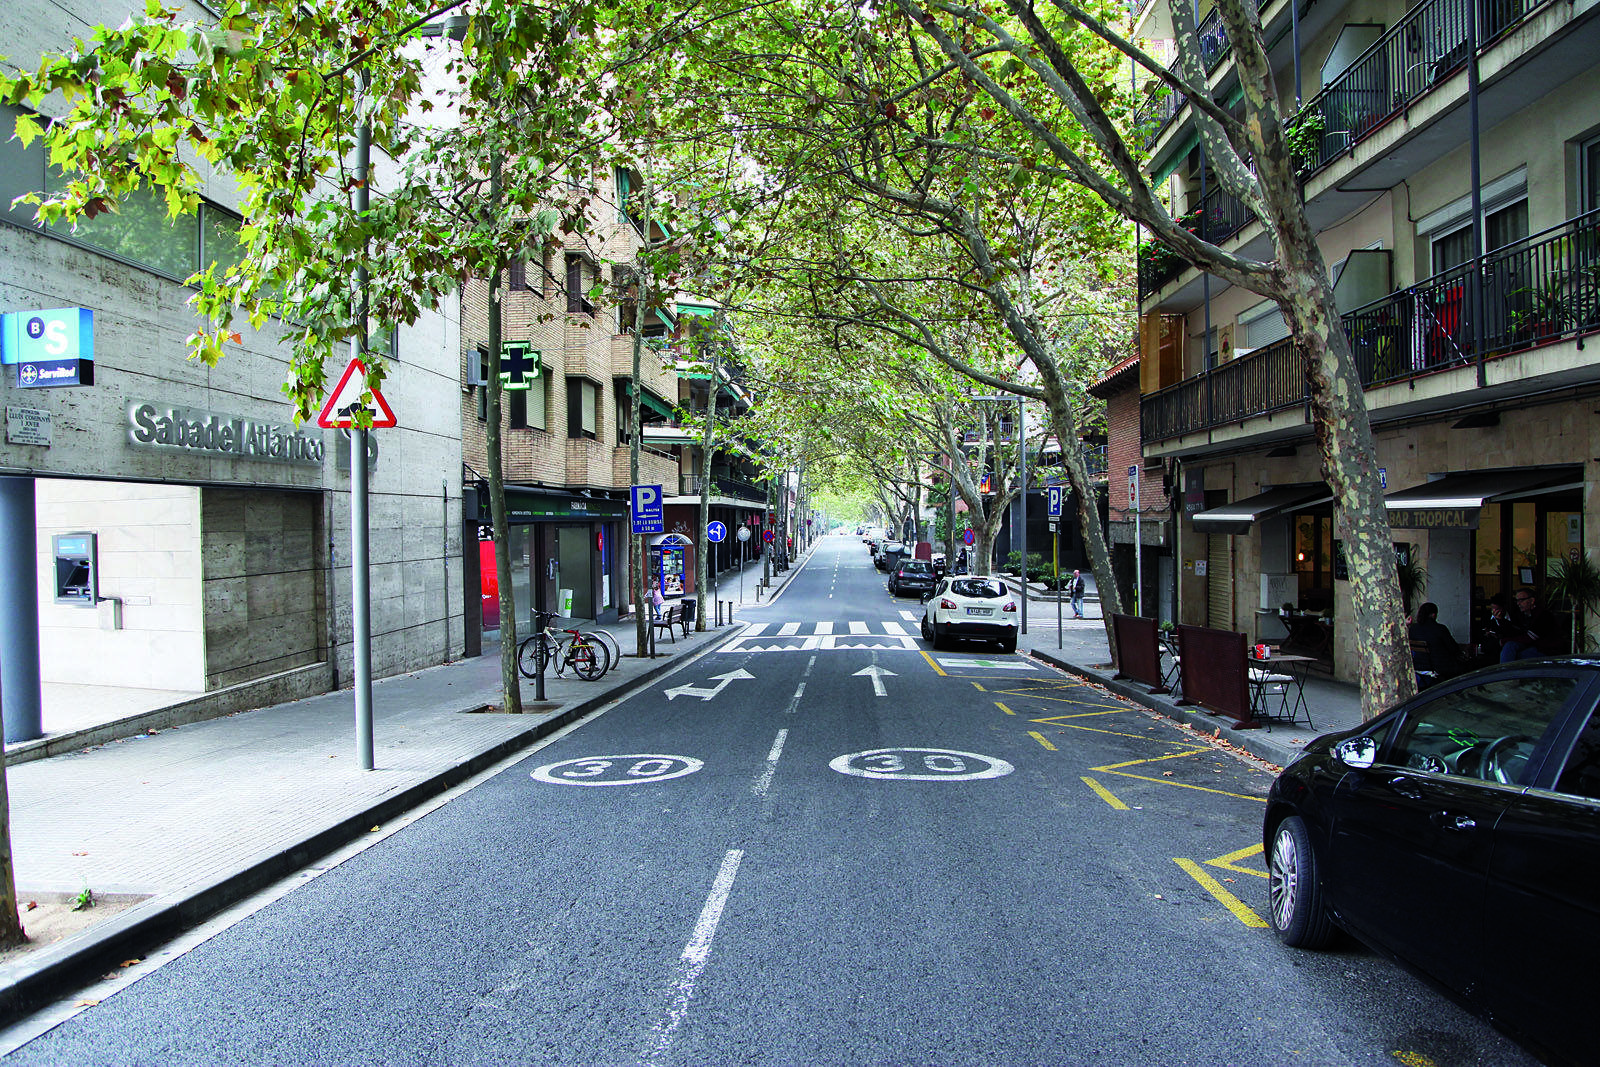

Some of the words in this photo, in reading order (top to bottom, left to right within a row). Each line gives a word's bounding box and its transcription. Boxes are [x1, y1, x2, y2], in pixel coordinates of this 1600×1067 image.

[30, 322, 41, 334] B
[45, 320, 68, 354] S
[134, 403, 244, 453] Sabadell
[245, 420, 325, 463] Atlántico
[636, 487, 657, 513] P
[1050, 489, 1059, 513] P
[1388, 510, 1409, 526] BAR
[1413, 510, 1469, 527] TROPICAL
[562, 759, 674, 777] 30
[864, 754, 967, 772] 30
